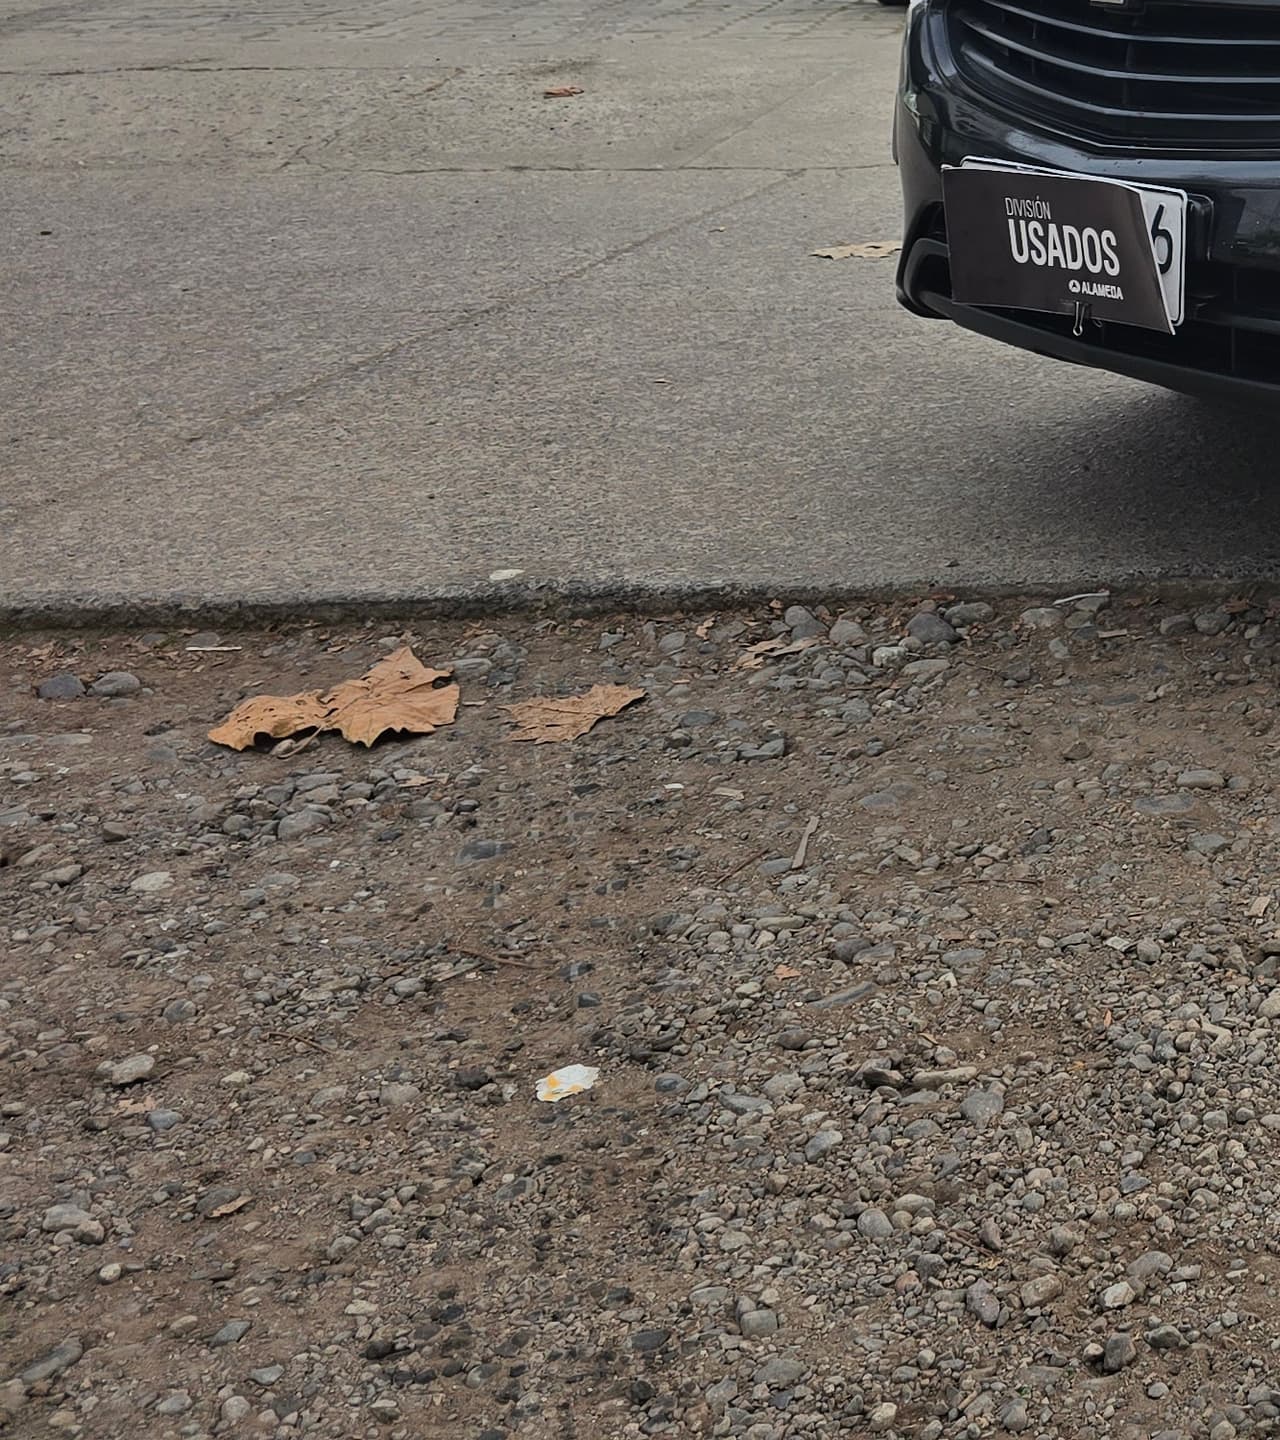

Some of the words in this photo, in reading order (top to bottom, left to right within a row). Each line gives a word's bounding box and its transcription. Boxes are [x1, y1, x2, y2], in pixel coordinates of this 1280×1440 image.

[1005, 195, 1051, 220] DIVISIÓN
[1008, 218, 1120, 276] USADOS
[1081, 281, 1124, 300] ALAMEDA
